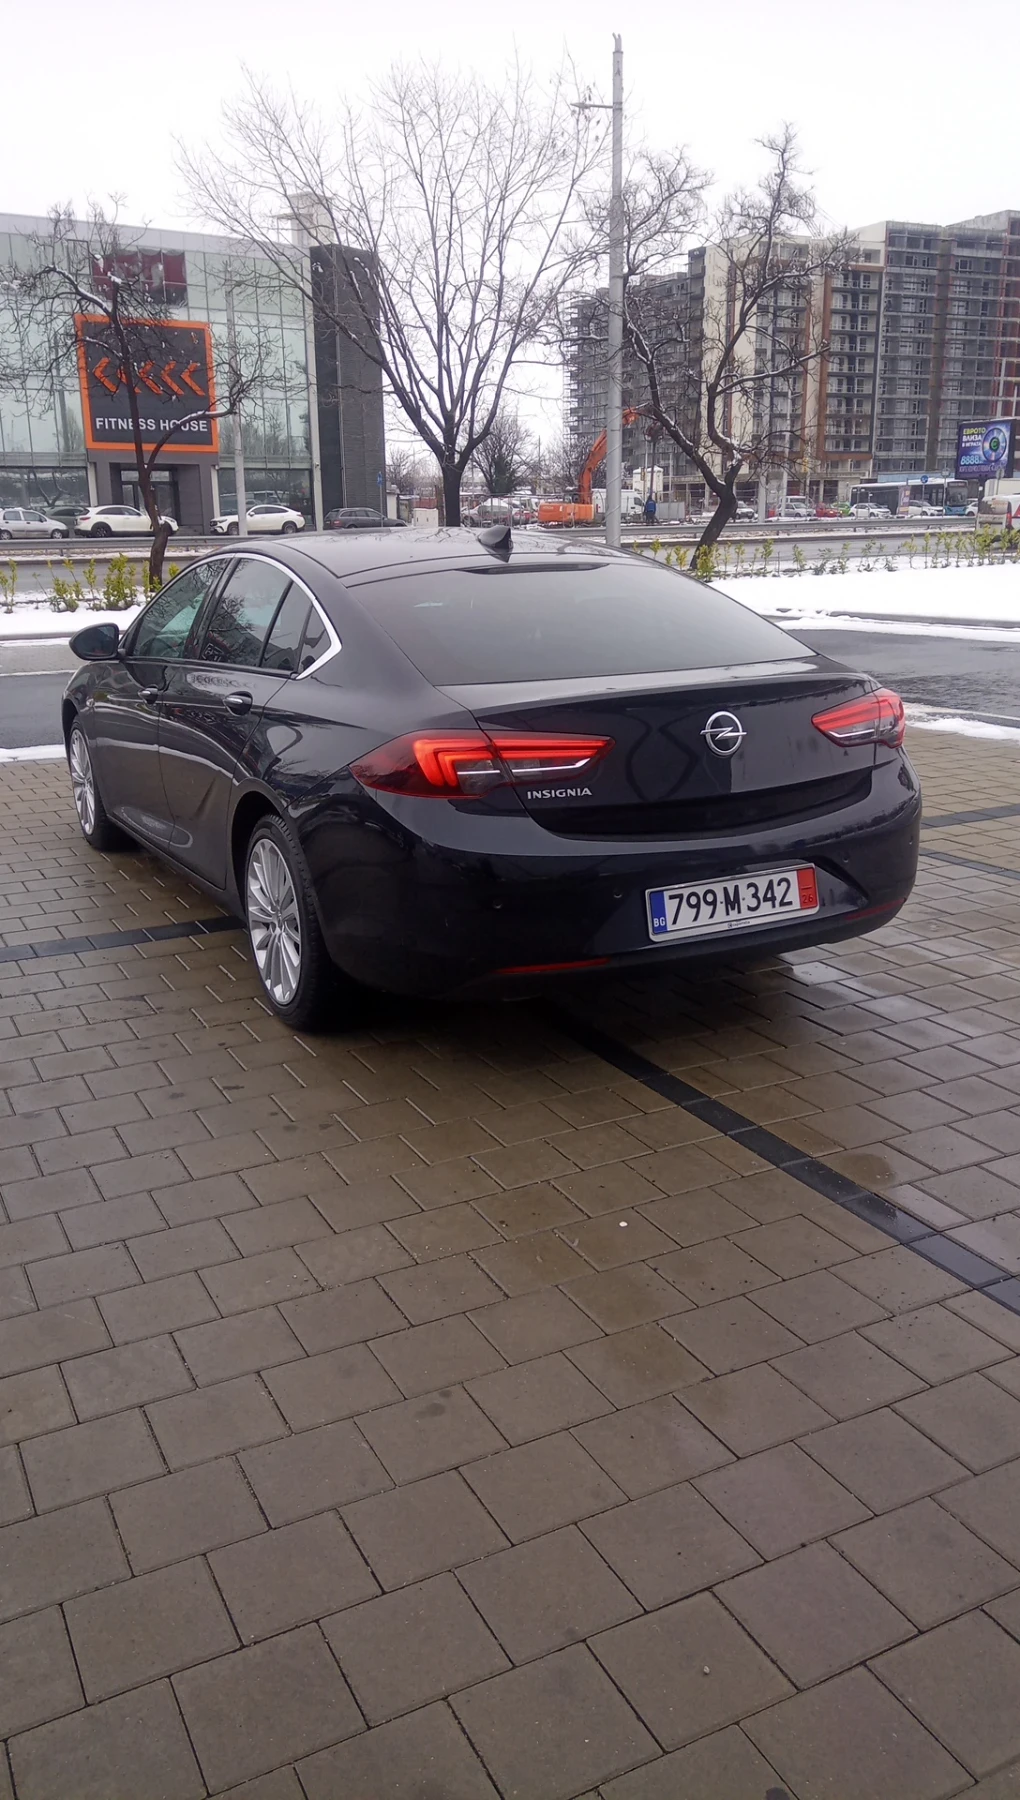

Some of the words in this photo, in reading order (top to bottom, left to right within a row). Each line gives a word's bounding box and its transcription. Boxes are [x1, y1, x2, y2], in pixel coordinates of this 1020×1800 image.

[527, 787, 593, 799] INSIGNIA
[801, 893, 814, 904] 26
[653, 917, 666, 927] BG
